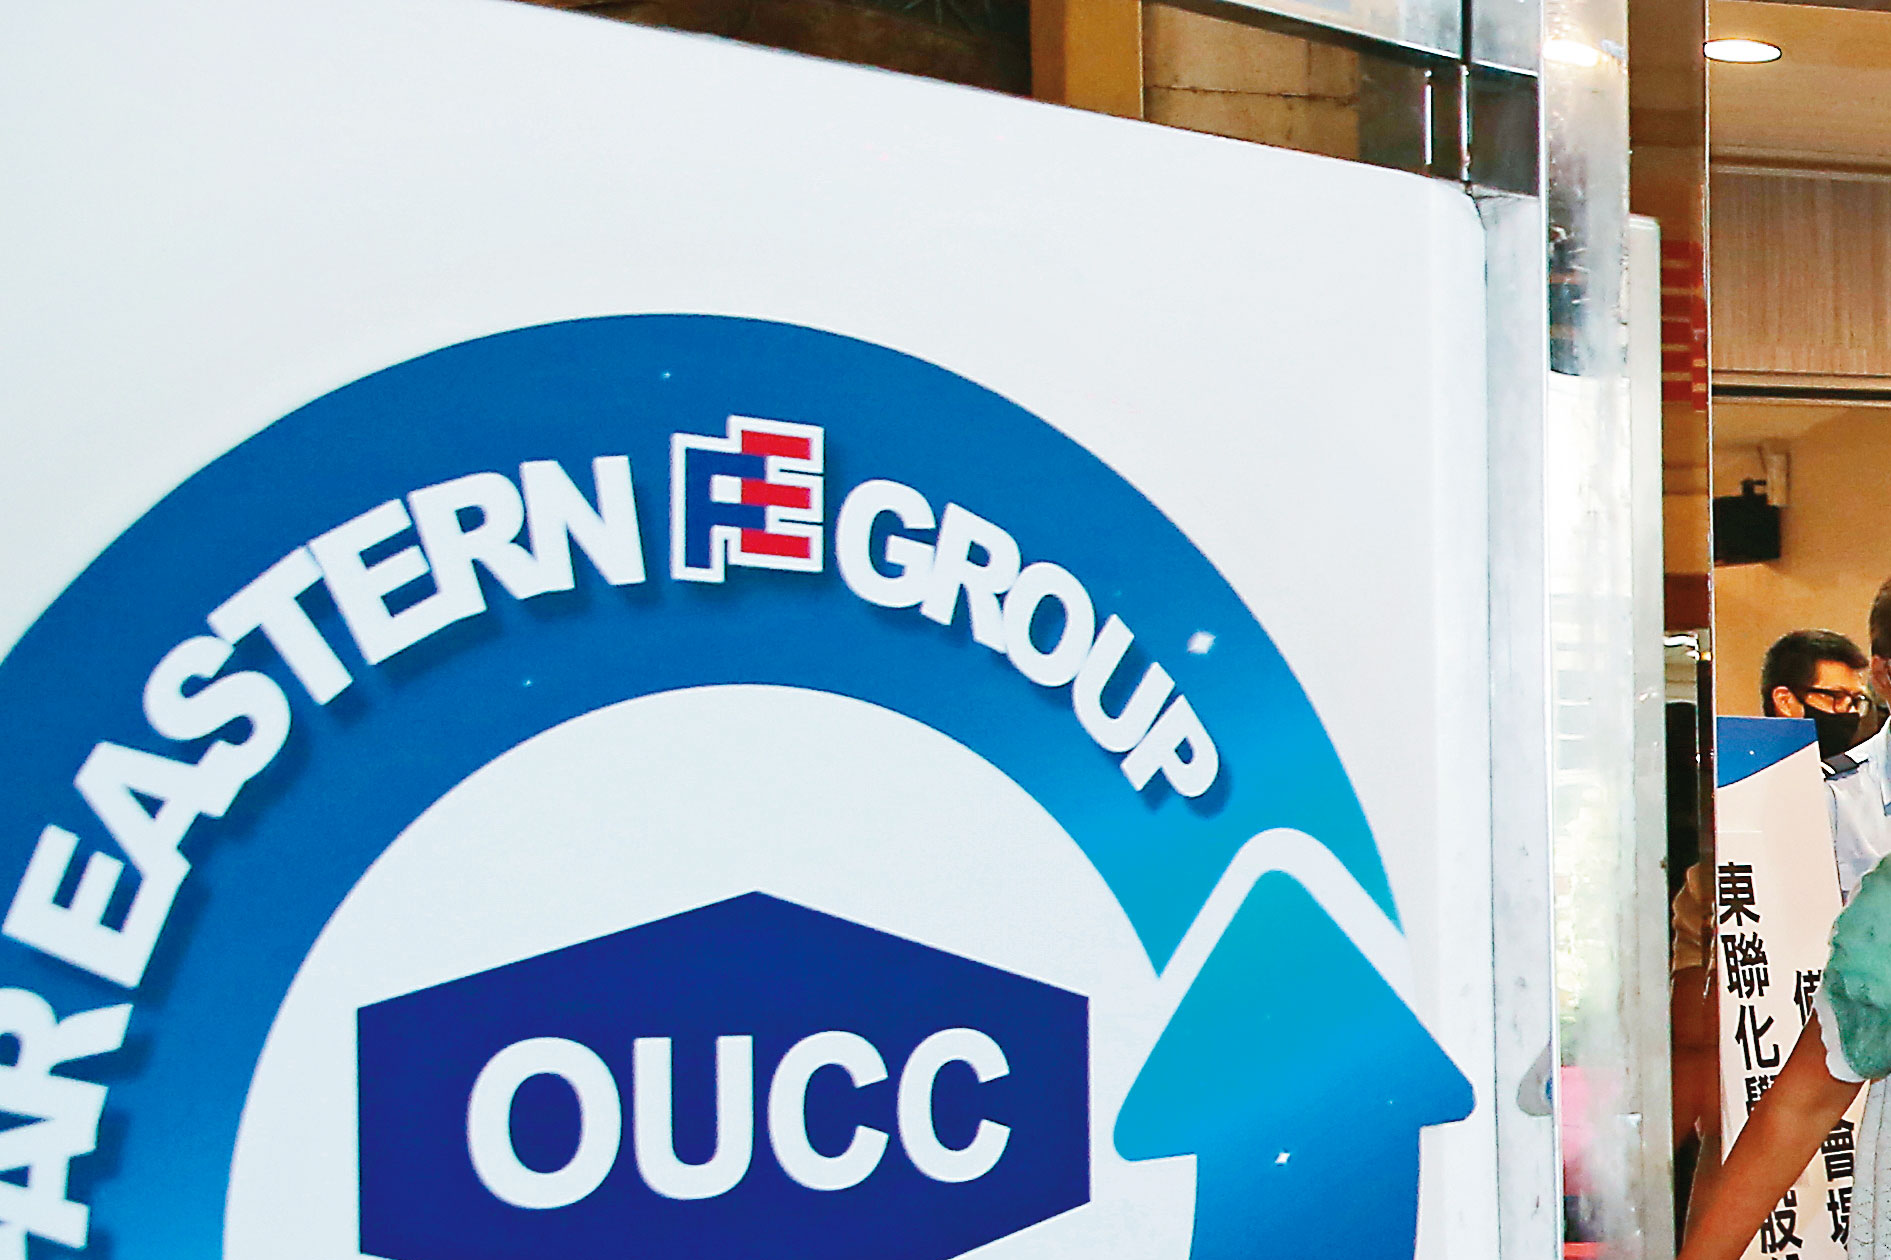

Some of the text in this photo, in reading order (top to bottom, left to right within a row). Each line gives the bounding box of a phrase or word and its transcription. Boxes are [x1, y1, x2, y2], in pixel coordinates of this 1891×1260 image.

[2, 455, 647, 989] EASTERN
[836, 478, 1220, 799] GROUP
[467, 1026, 1012, 1210] OUCC
